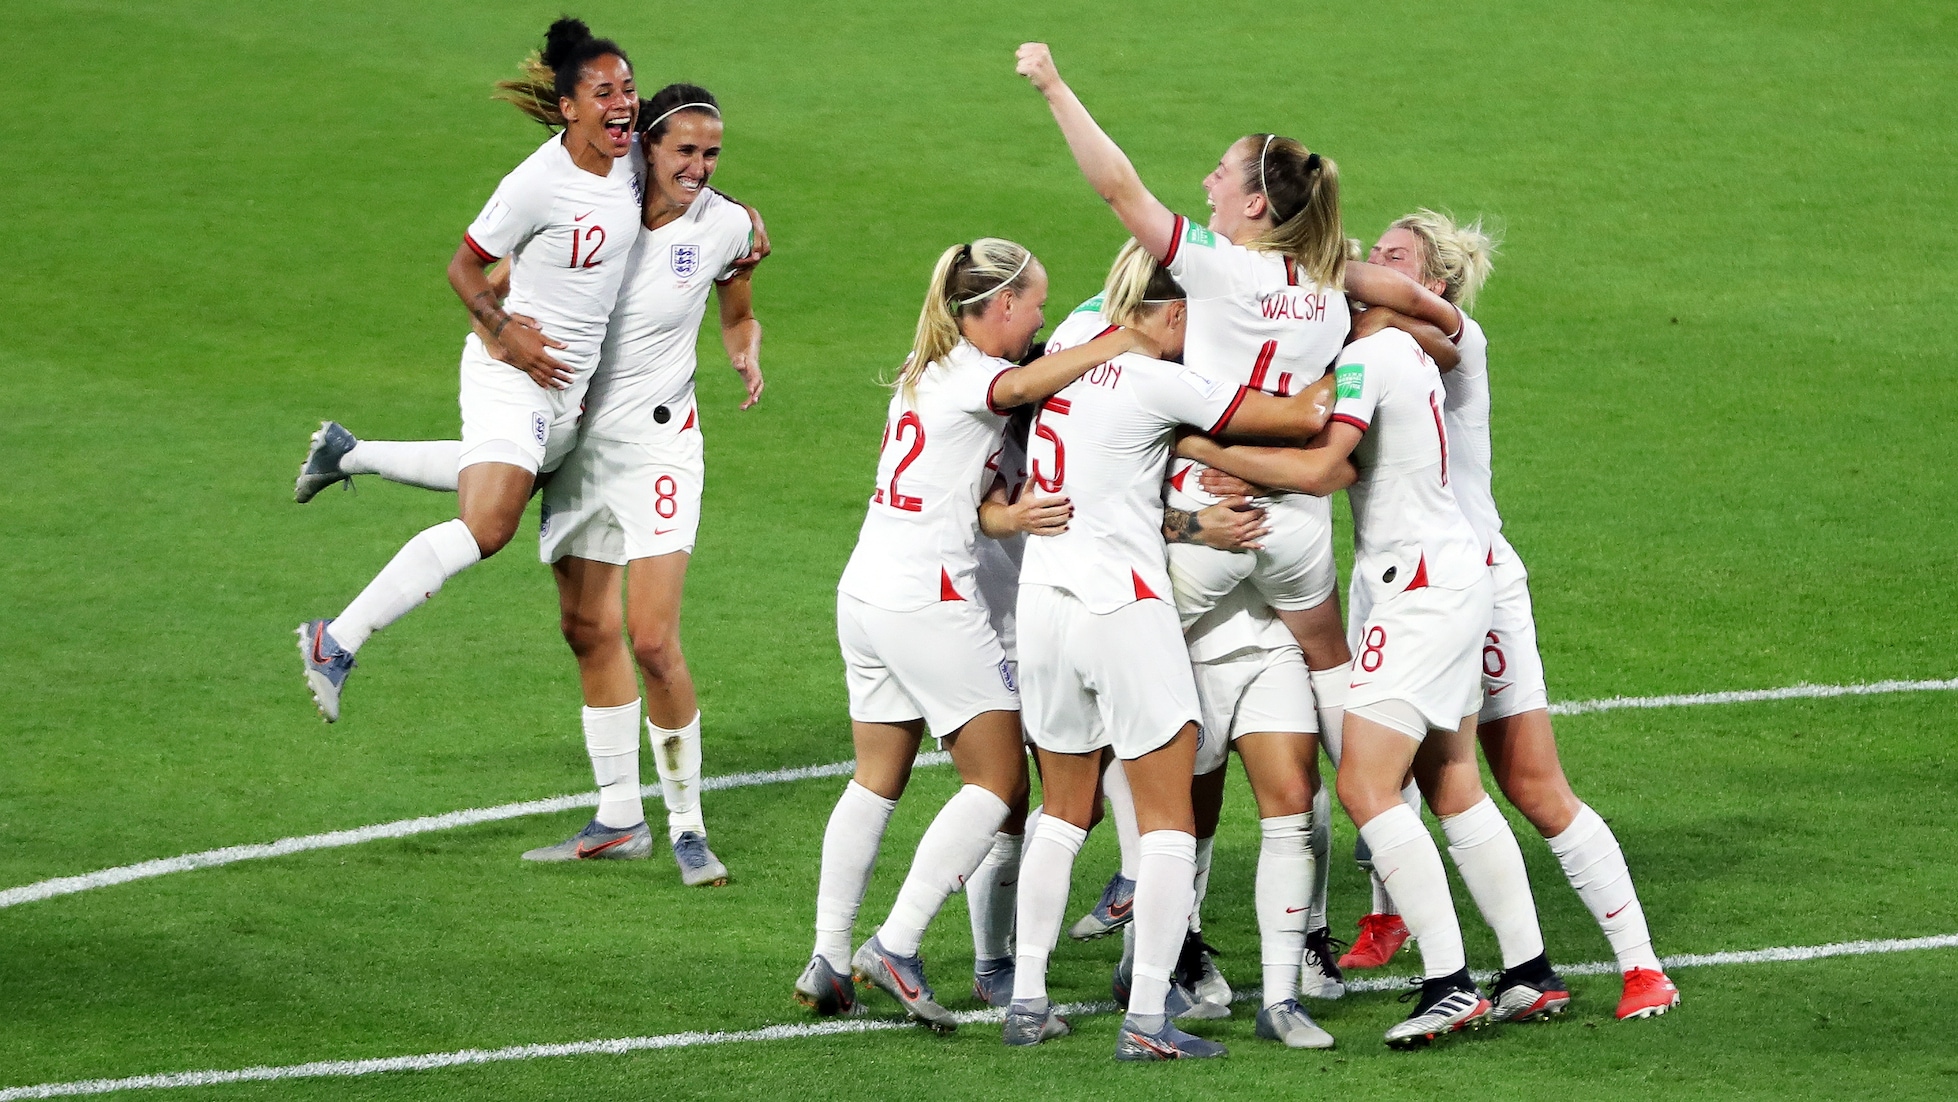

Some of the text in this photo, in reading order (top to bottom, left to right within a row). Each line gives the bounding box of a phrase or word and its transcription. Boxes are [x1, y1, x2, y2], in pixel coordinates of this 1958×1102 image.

[570, 225, 606, 268] 12
[1261, 293, 1326, 322] WALSH
[1033, 395, 1072, 493] 5
[655, 475, 677, 519] 8
[1351, 625, 1387, 673] 18
